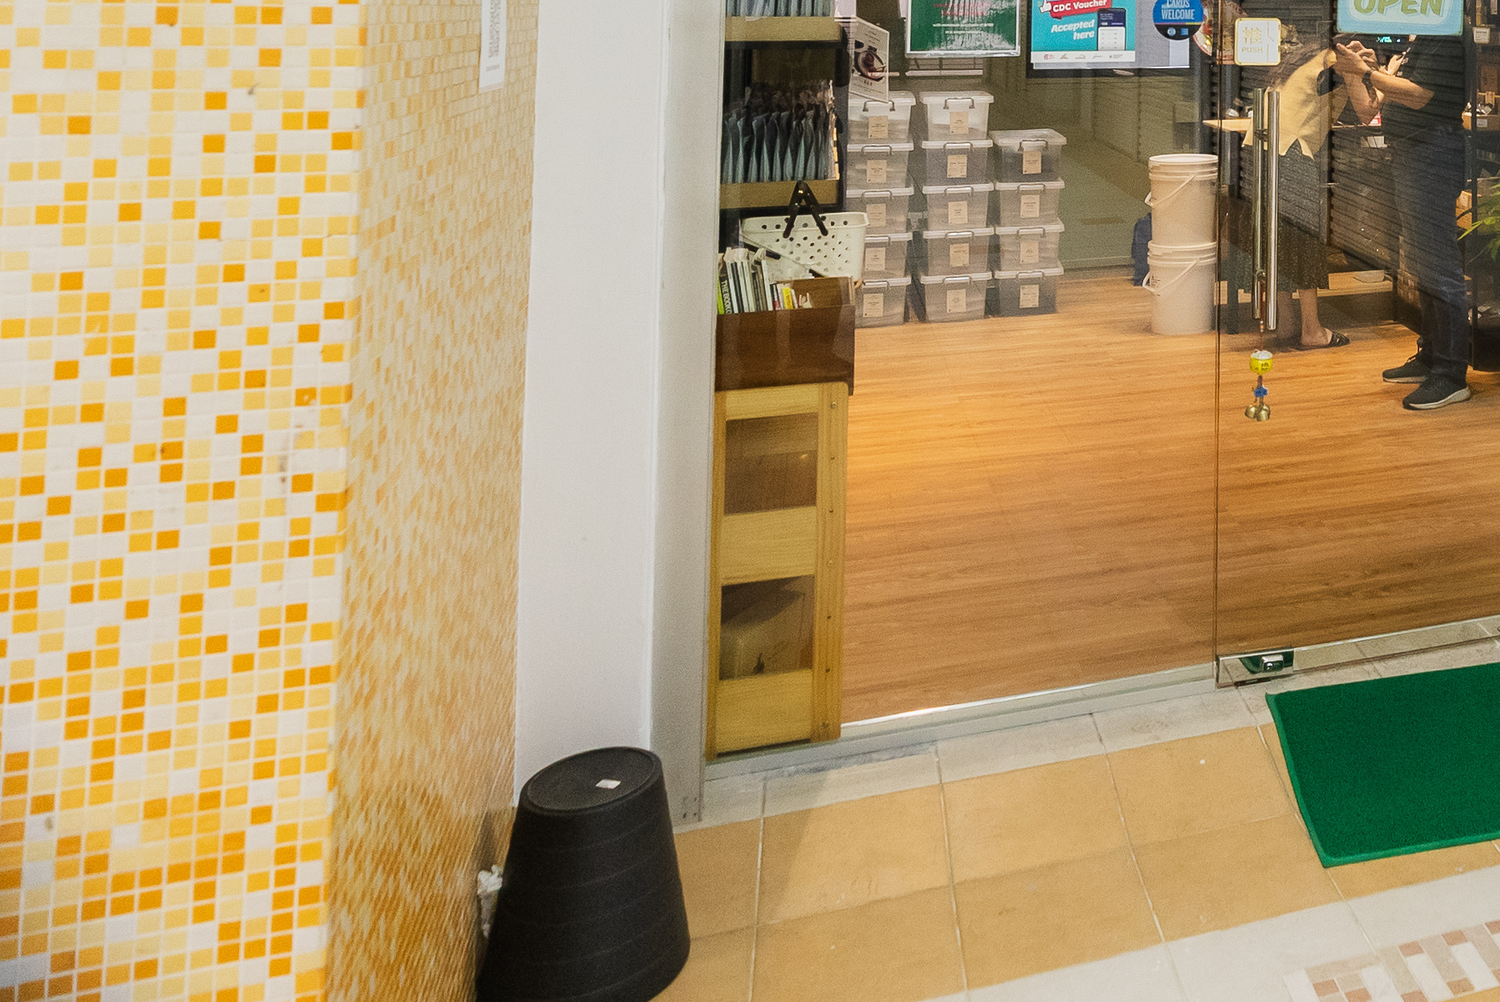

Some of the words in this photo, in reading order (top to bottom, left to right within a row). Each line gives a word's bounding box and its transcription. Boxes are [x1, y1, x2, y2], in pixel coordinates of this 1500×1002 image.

[1052, 3, 1071, 12] CDC
[1073, 0, 1107, 9] Voucher
[1161, 8, 1195, 20] WELCOME
[1050, 19, 1095, 33] Accepted
[1072, 30, 1095, 40] here
[1242, 27, 1262, 44] 推
